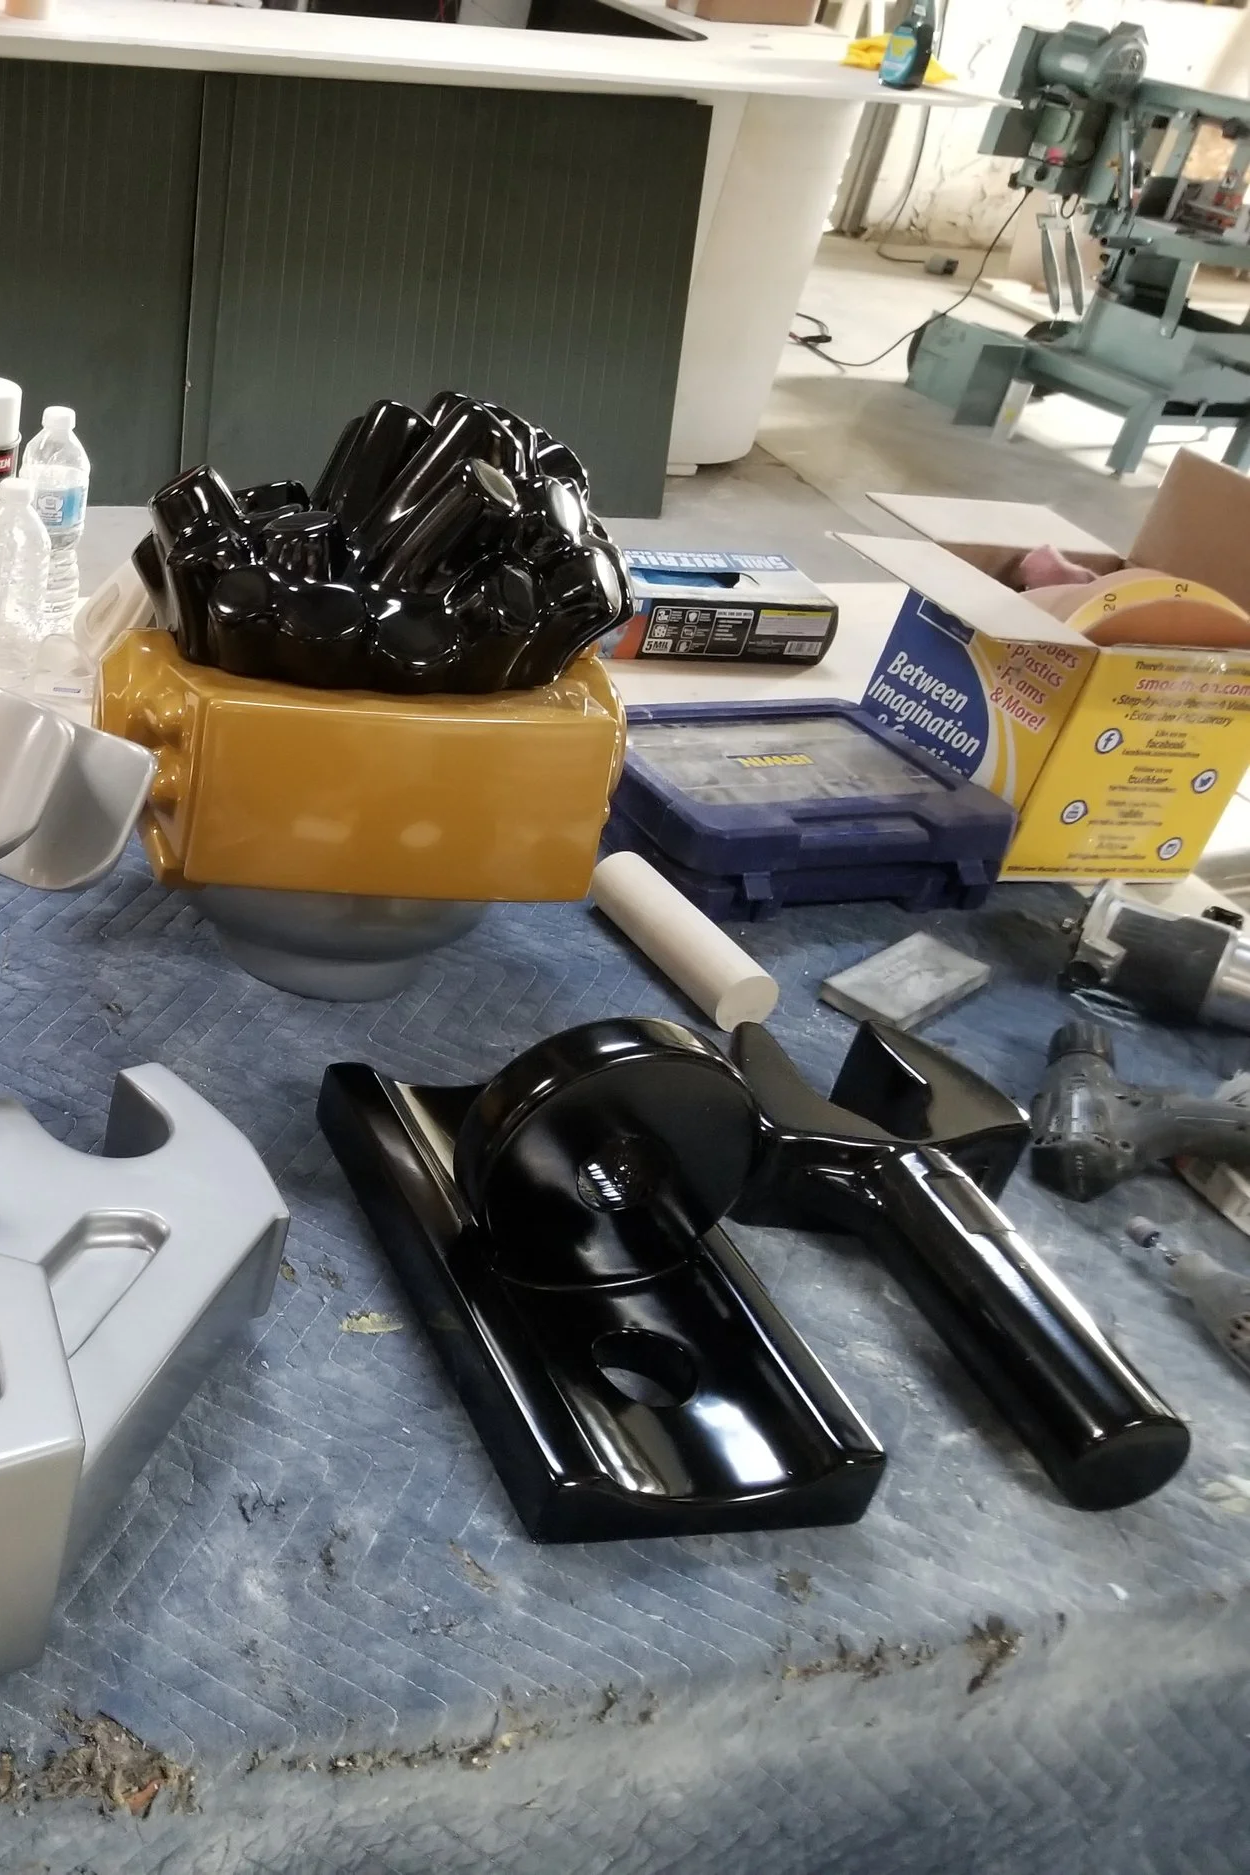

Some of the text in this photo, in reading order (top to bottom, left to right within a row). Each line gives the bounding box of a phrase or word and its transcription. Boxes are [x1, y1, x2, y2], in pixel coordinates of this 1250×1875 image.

[887, 651, 969, 713] Between
[867, 674, 981, 758] Imagination
[990, 687, 1046, 731] & More!
[736, 754, 815, 769] IRWIN
